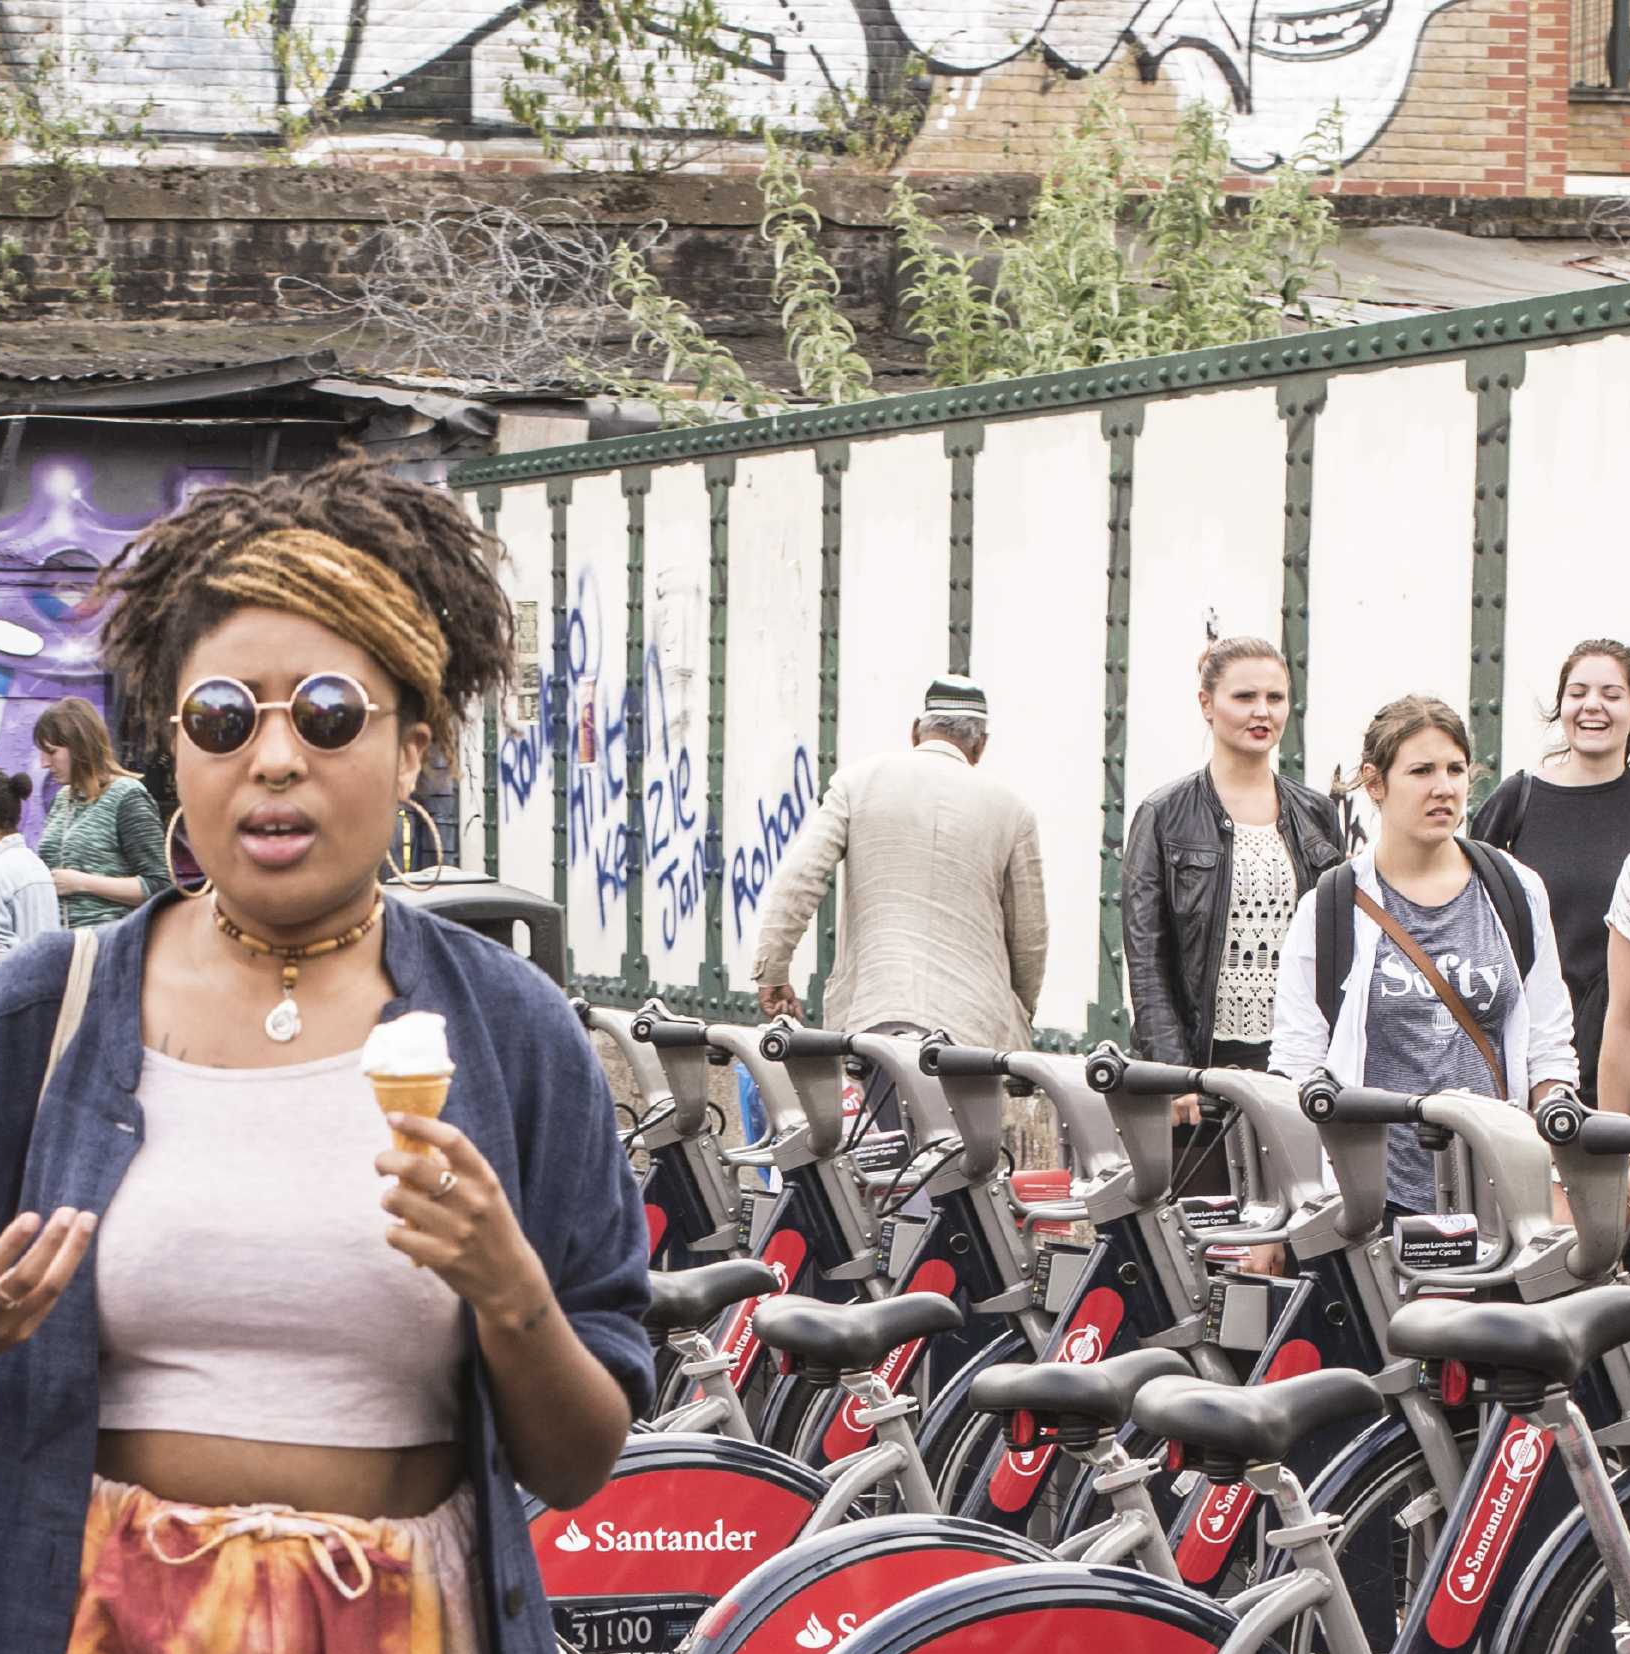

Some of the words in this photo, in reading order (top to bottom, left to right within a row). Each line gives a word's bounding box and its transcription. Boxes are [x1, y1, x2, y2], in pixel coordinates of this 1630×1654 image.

[731, 745, 816, 943] Rohan
[1381, 952, 1503, 1011] Softy
[1210, 1218, 1229, 1226] Cycles
[1404, 1242, 1430, 1250] Explore
[1439, 1249, 1461, 1257] Cycles
[596, 1518, 757, 1552] Santander
[1465, 1482, 1515, 1574] Santander
[572, 1616, 652, 1650] 31100
